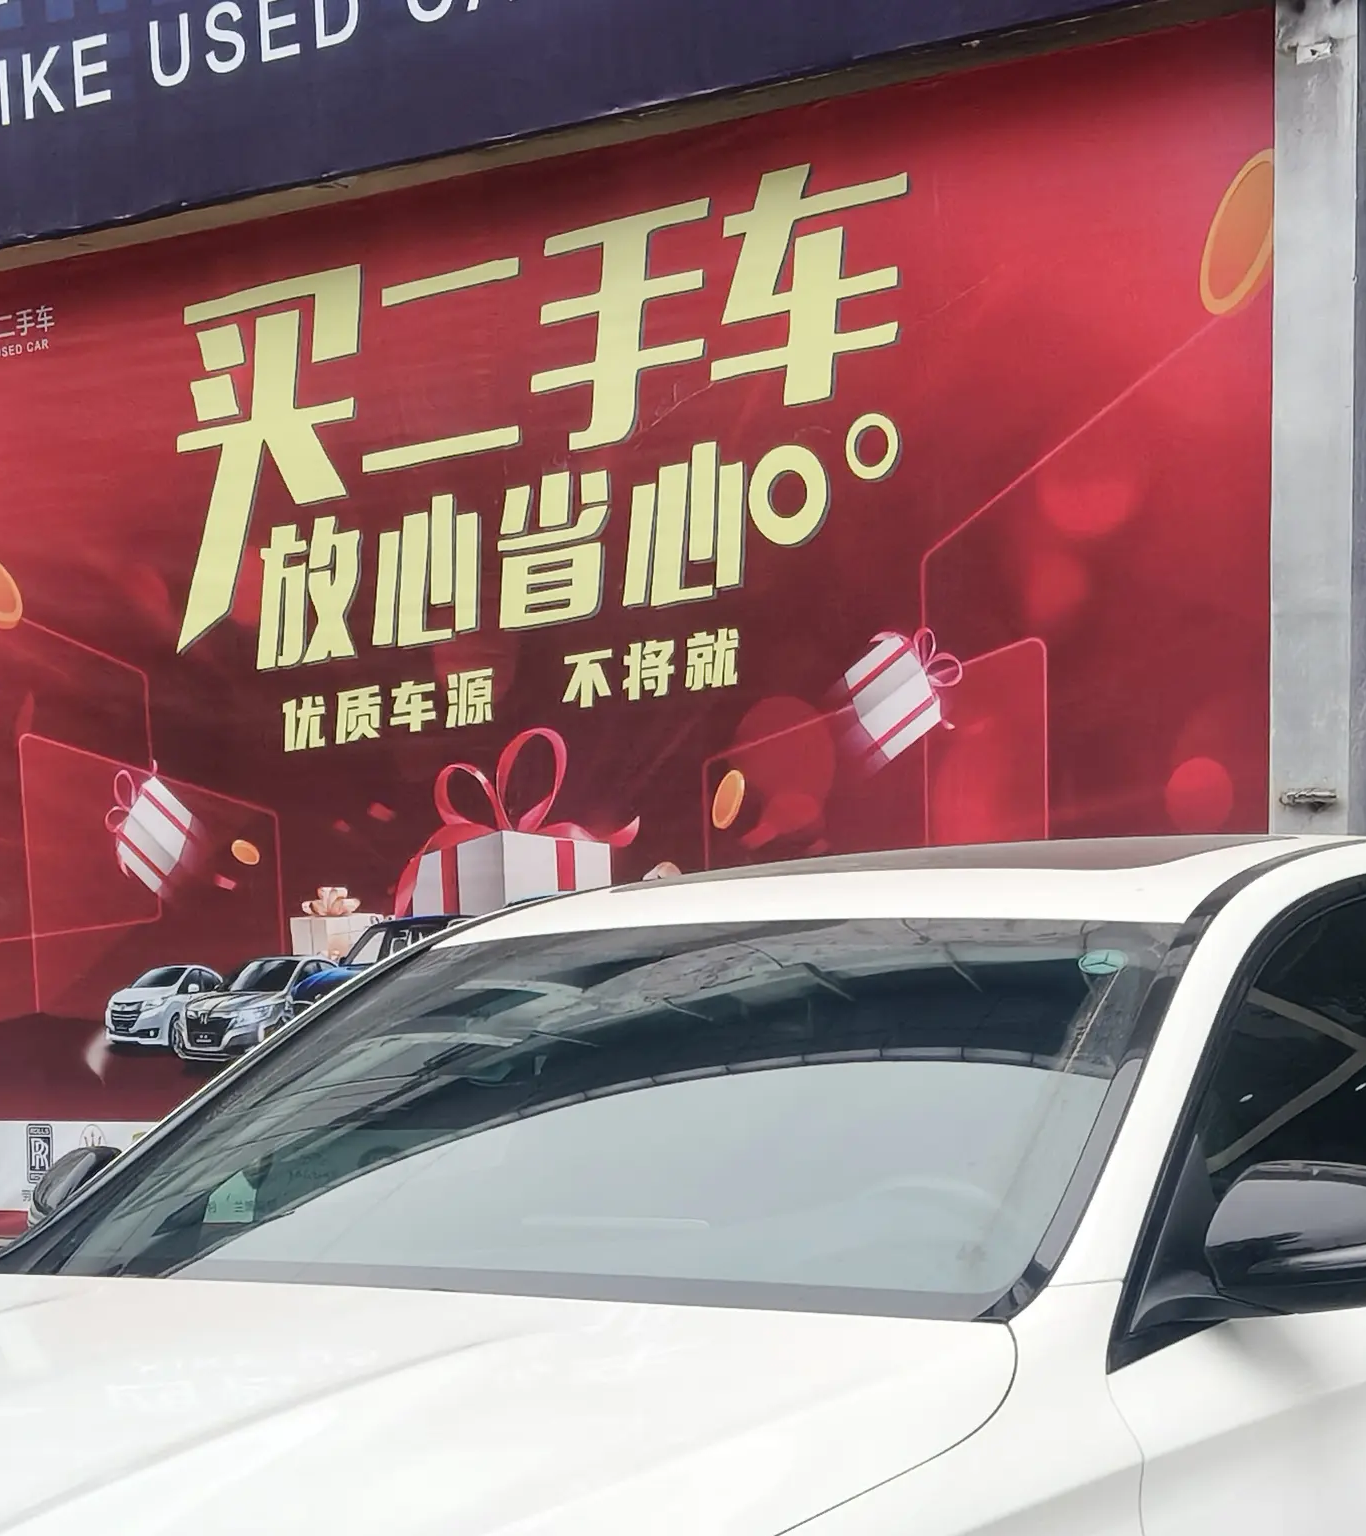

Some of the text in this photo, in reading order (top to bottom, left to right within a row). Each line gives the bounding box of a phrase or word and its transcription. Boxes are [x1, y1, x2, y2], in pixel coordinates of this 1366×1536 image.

[148, 0, 359, 87] USED
[26, 338, 49, 352] CAR
[176, 163, 909, 655] 买二手车
[256, 441, 745, 670] 放心省心
[282, 627, 740, 753] 优质车源 不将就
